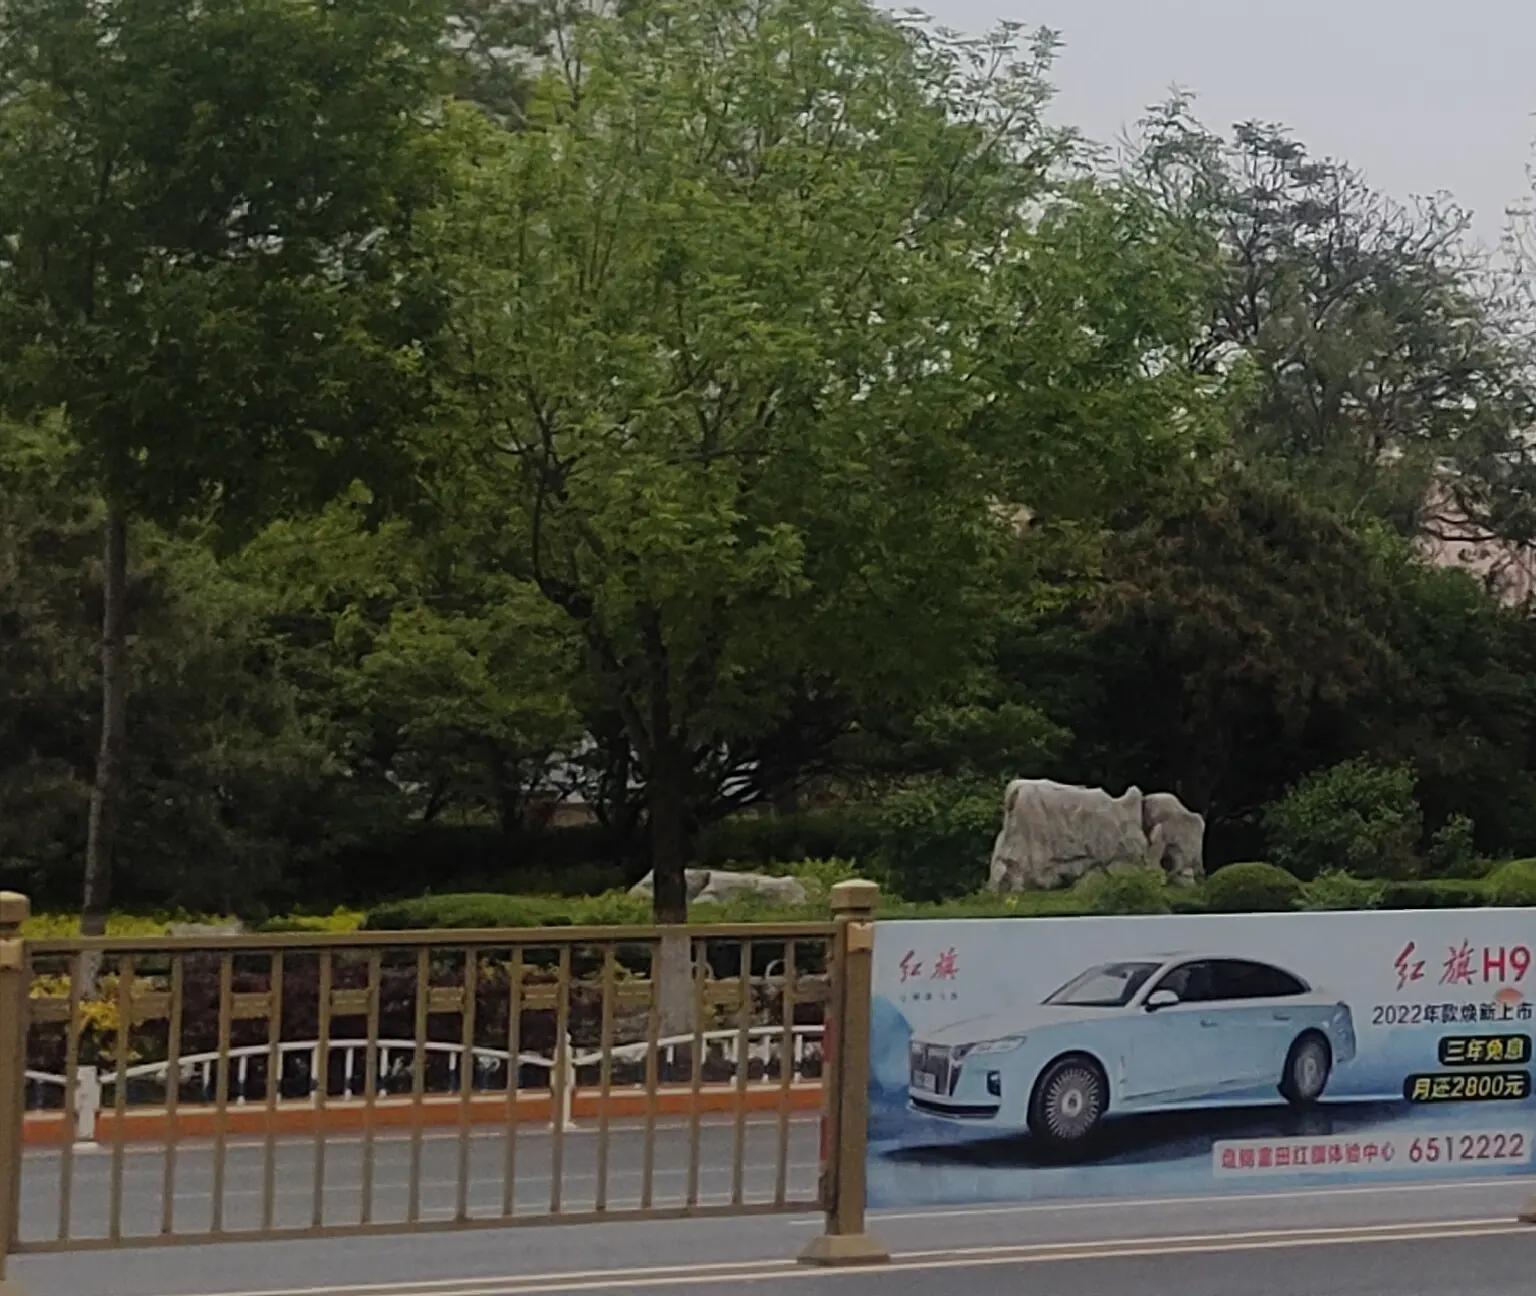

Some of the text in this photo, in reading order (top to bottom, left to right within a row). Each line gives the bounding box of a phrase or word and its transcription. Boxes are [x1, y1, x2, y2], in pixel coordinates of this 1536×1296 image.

[899, 947, 960, 984] 红旗
[1444, 1037, 1525, 1062] 三年免息
[1412, 1074, 1526, 1101] 月还2800元
[1408, 1132, 1525, 1163] 6512222
